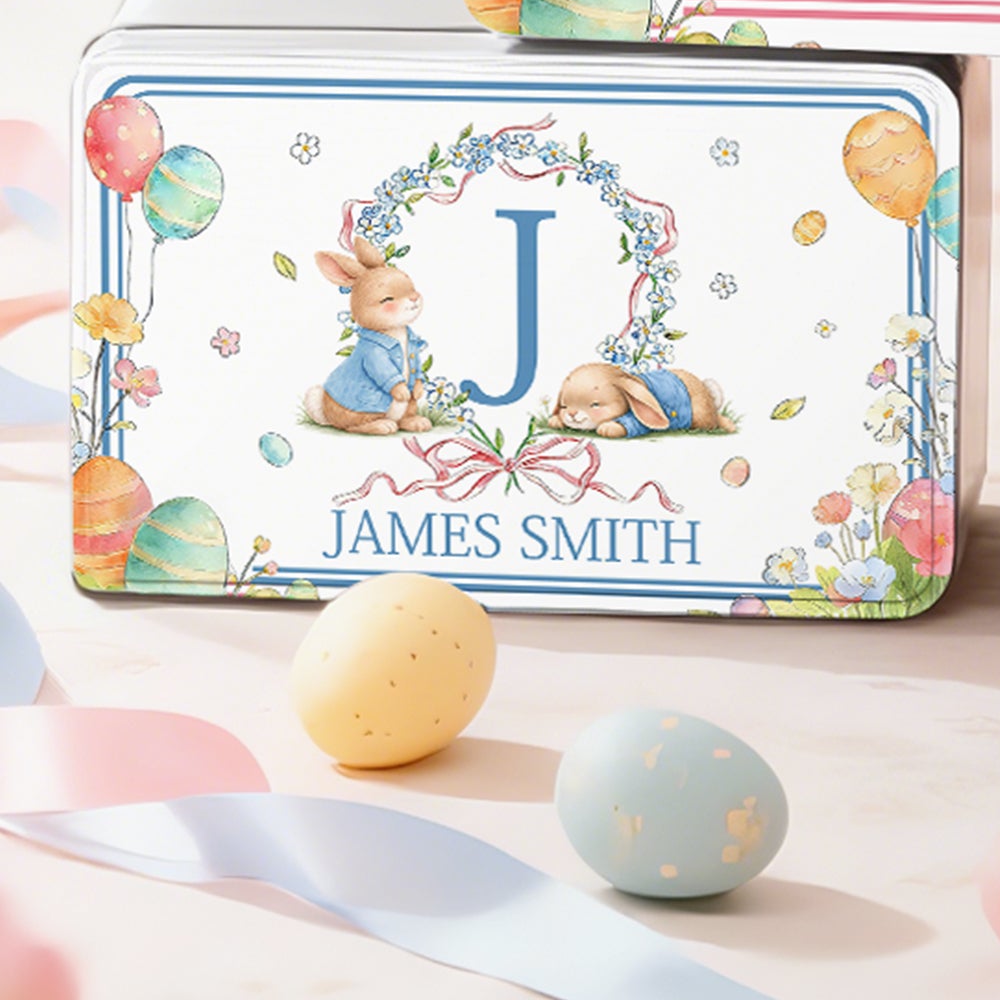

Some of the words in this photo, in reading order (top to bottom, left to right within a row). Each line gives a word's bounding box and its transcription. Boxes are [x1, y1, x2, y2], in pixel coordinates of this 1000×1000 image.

[459, 209, 557, 407] J
[321, 509, 501, 560] JAMES
[521, 514, 701, 565] SMITH
